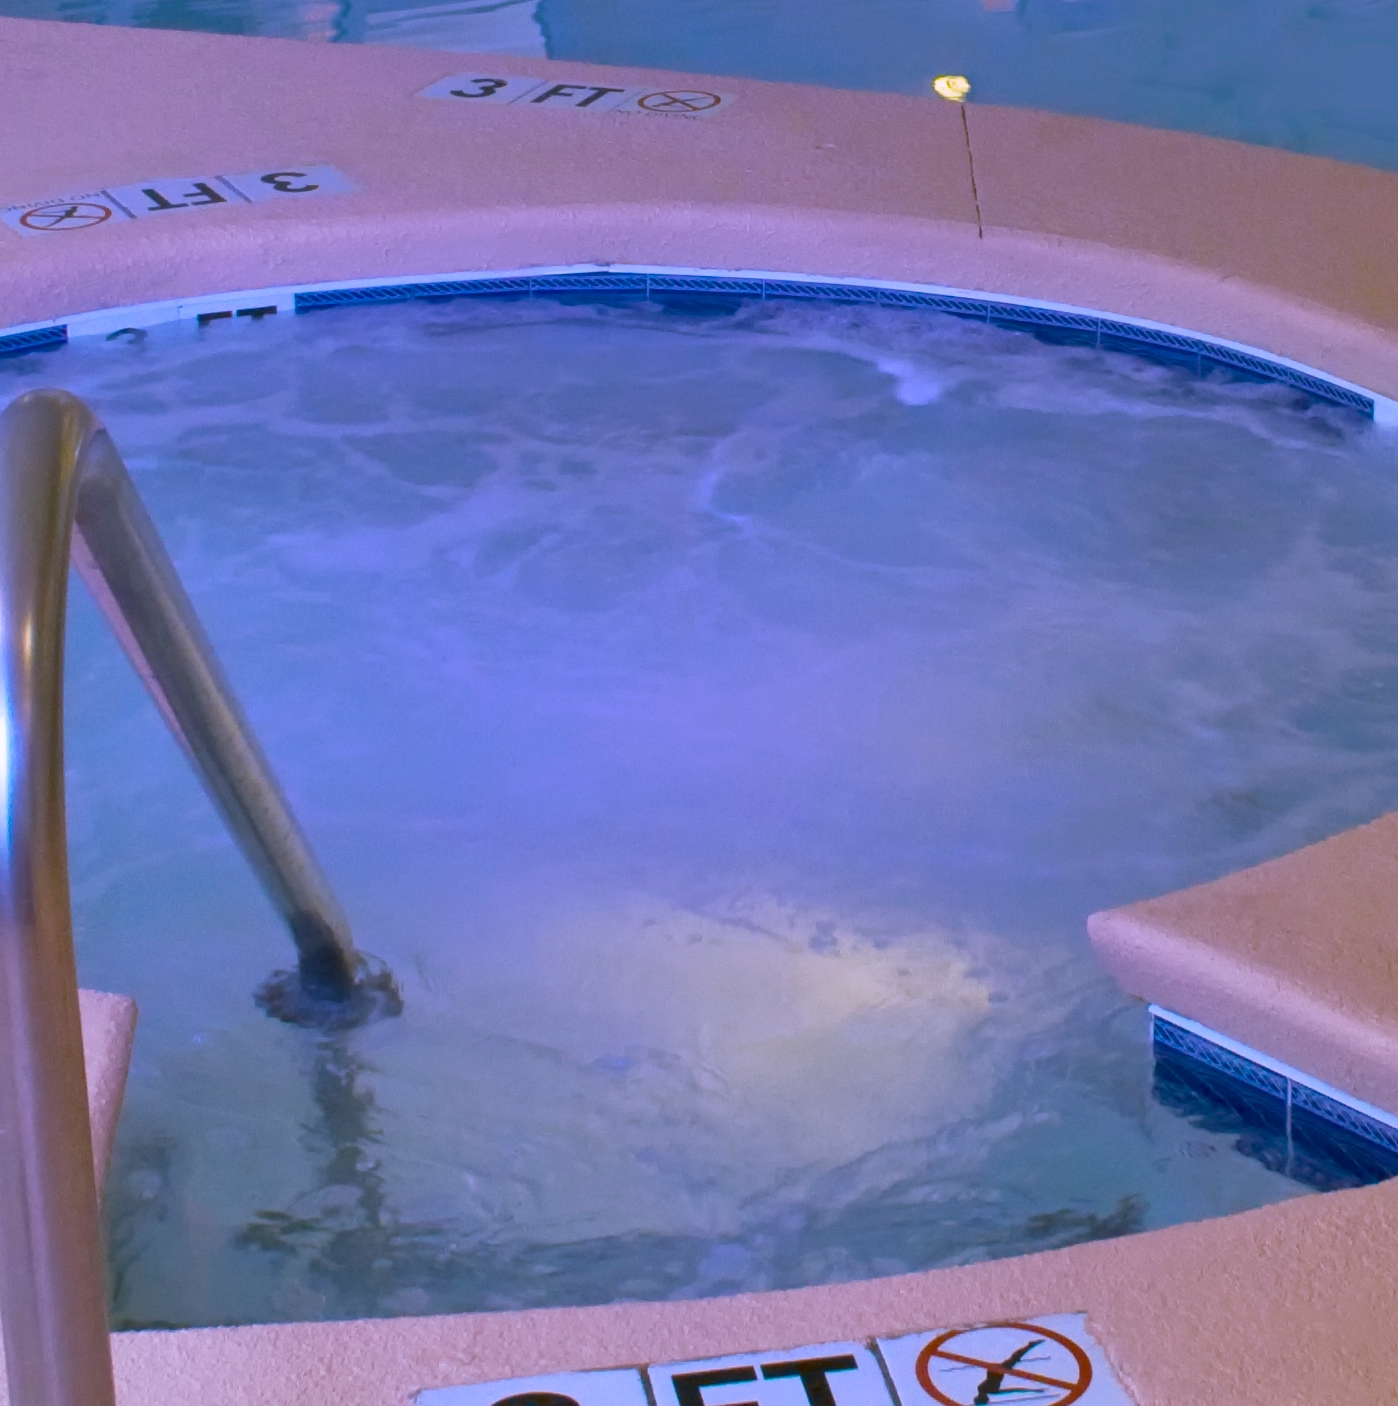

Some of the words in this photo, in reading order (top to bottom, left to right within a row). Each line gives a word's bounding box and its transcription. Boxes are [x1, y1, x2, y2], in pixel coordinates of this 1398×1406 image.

[450, 78, 508, 98] 3
[530, 84, 625, 108] FT
[141, 182, 228, 212] FT
[260, 172, 320, 193] 3
